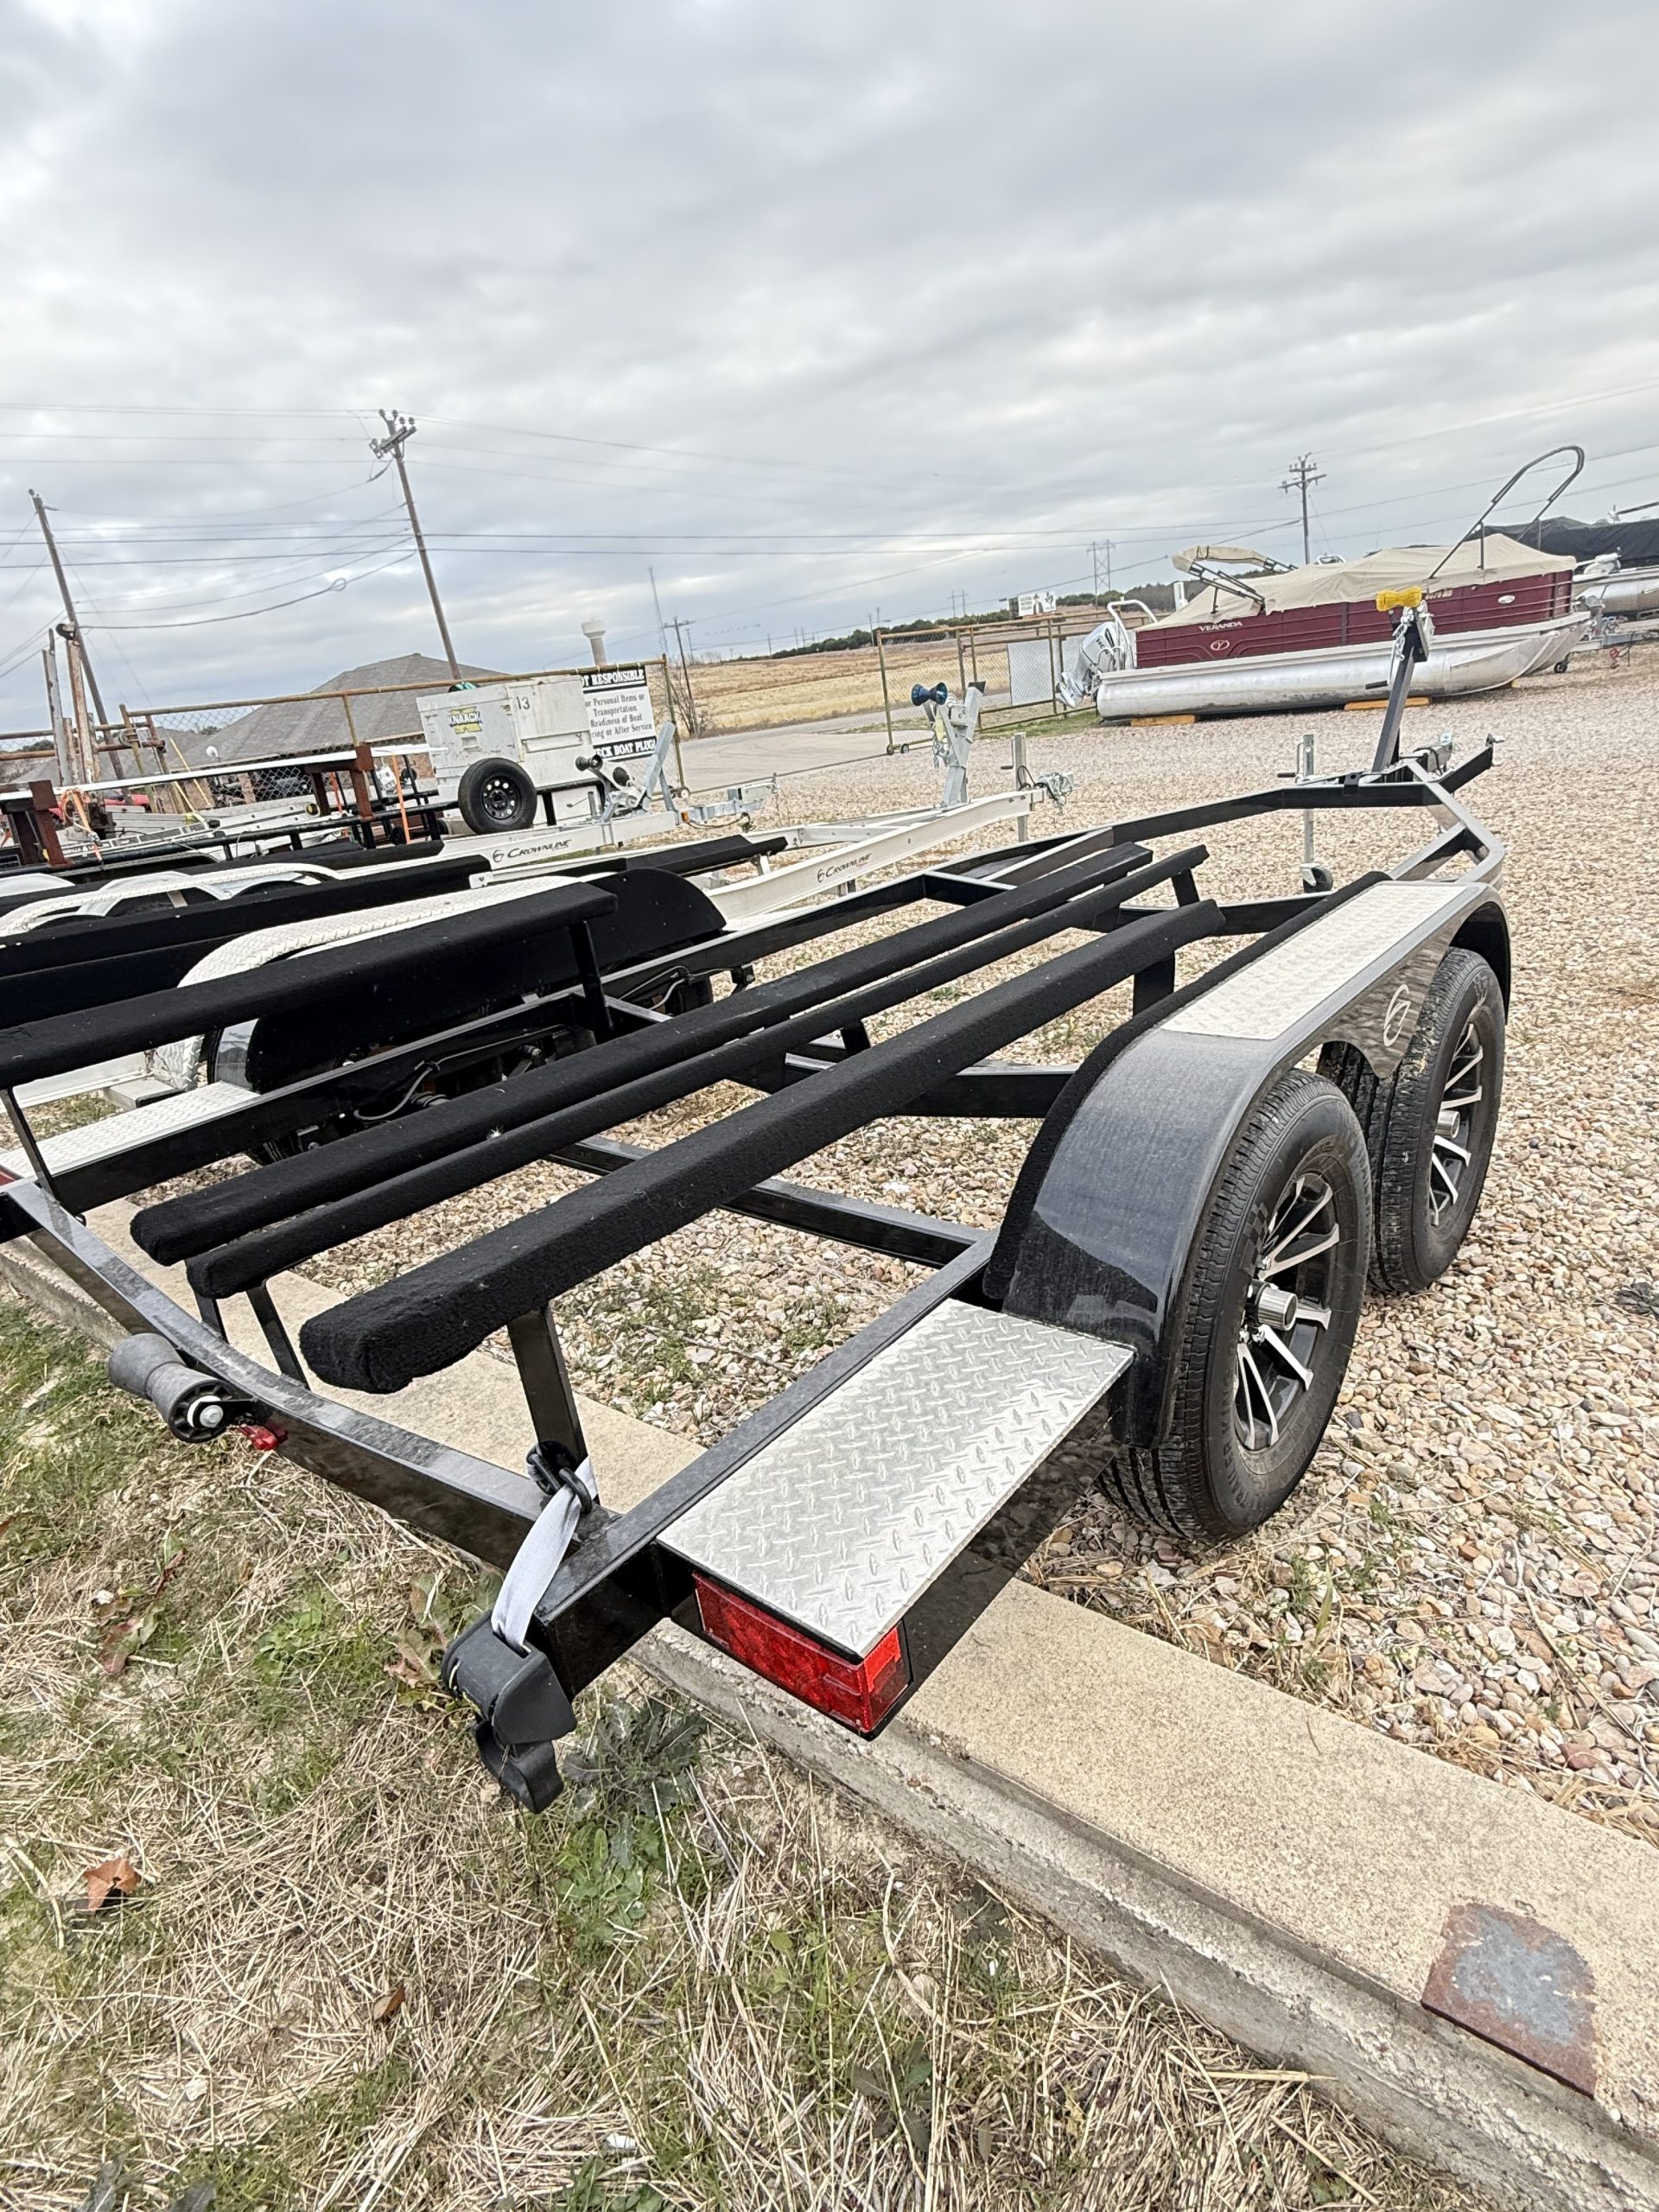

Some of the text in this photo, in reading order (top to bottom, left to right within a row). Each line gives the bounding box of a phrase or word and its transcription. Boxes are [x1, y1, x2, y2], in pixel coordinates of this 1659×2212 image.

[1198, 620, 1243, 632] VERANDA
[591, 669, 645, 685] RESPONSIBLE
[516, 696, 531, 709] 13
[593, 696, 619, 706] Personal
[620, 694, 637, 702] Items
[593, 704, 638, 716] Transportation
[448, 711, 482, 726] KNAACK
[590, 717, 620, 728] Readiness
[614, 726, 630, 734] After
[631, 722, 652, 732] Service
[614, 742, 634, 755] BOAT
[507, 839, 572, 858] CROWNLINE
